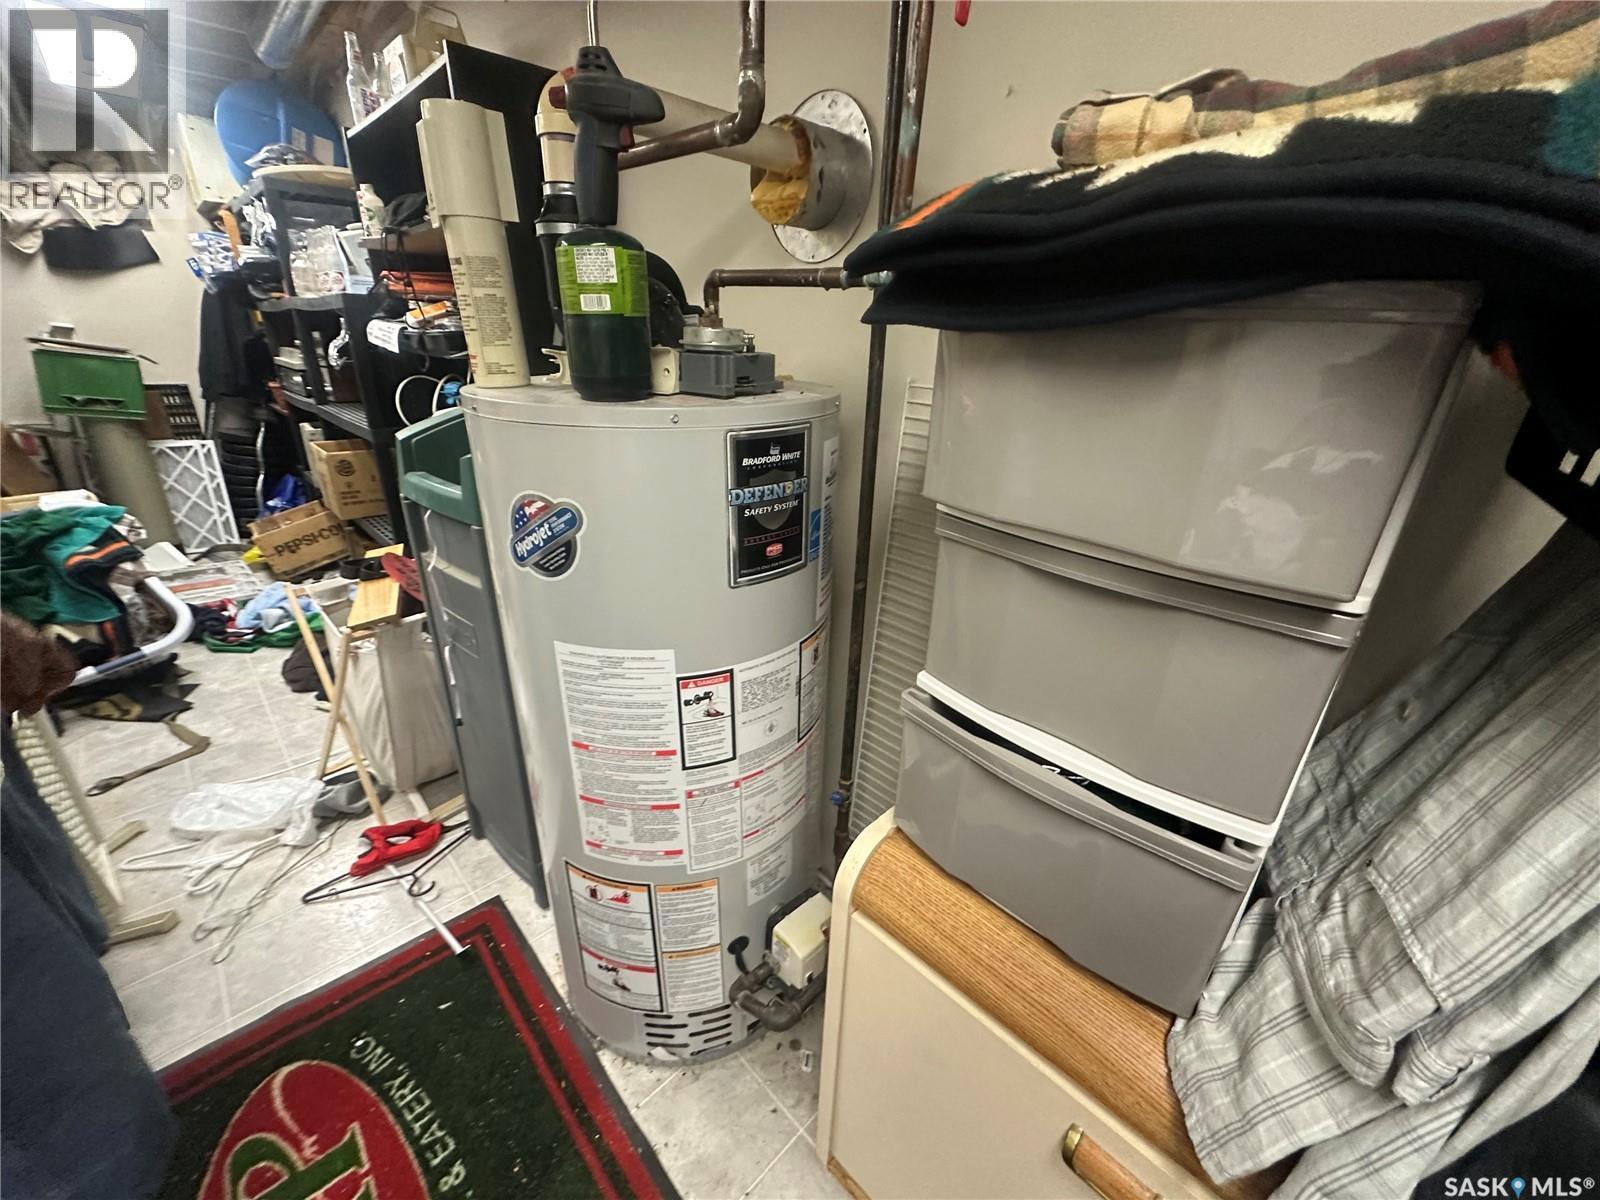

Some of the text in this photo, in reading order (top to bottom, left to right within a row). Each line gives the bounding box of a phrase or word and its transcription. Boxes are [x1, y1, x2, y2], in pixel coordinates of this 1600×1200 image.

[742, 455, 781, 466] BRADFORD
[782, 451, 801, 462] WHITE
[730, 477, 808, 505] DEFENDER
[744, 499, 799, 517] SAFETY SYSTEM
[514, 522, 552, 557] Hydrojet
[383, 1061, 456, 1167] EATERY,
[437, 1158, 467, 1192] &
